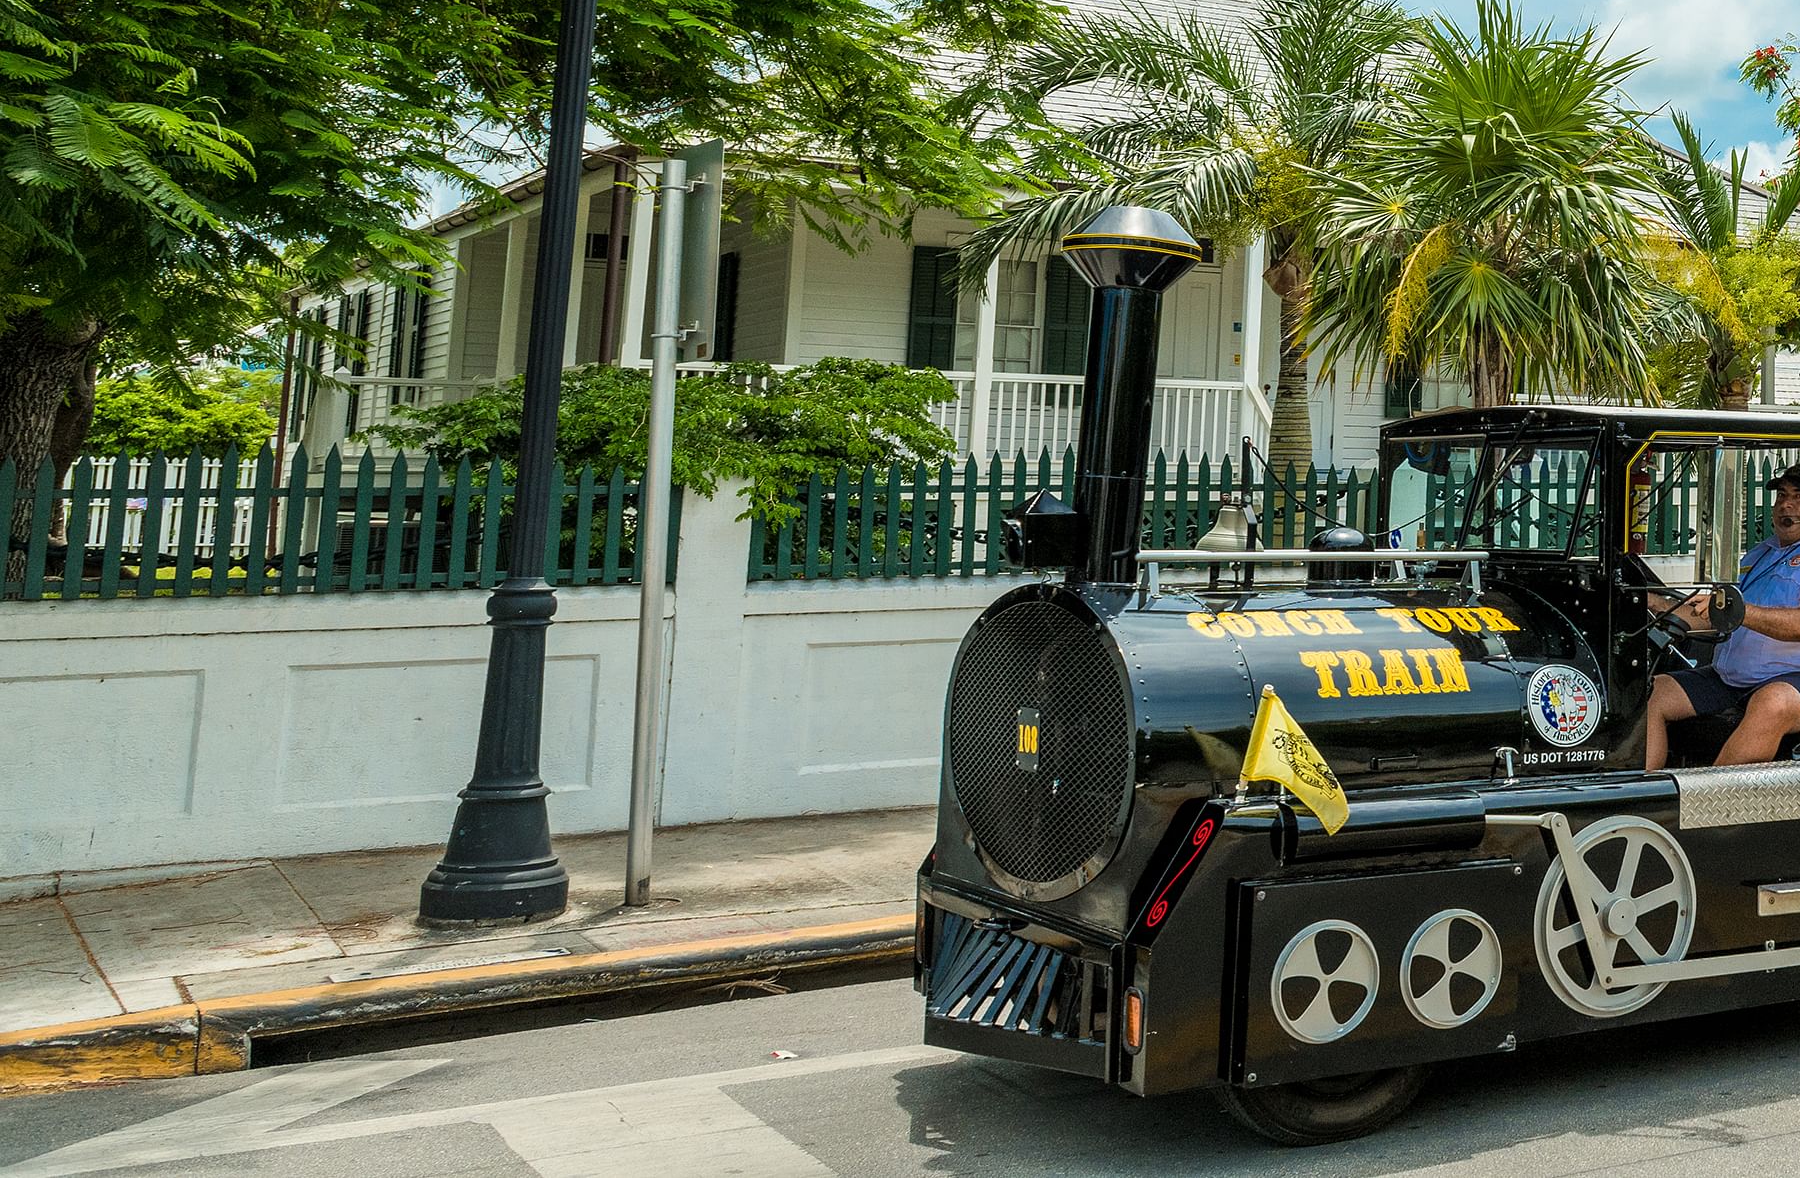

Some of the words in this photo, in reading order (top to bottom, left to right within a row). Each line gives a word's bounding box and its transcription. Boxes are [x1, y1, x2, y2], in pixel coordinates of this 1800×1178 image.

[1186, 608, 1364, 639] CONCH
[1375, 606, 1521, 634] TOUR
[1298, 647, 1472, 699] TRAIN
[1531, 670, 1553, 706] Historic
[1572, 671, 1596, 703] Tours
[1018, 724, 1038, 754] 108
[1552, 722, 1591, 742] America
[1523, 753, 1539, 765] US
[1540, 751, 1564, 764] DOT
[1565, 750, 1605, 763] 1281776
